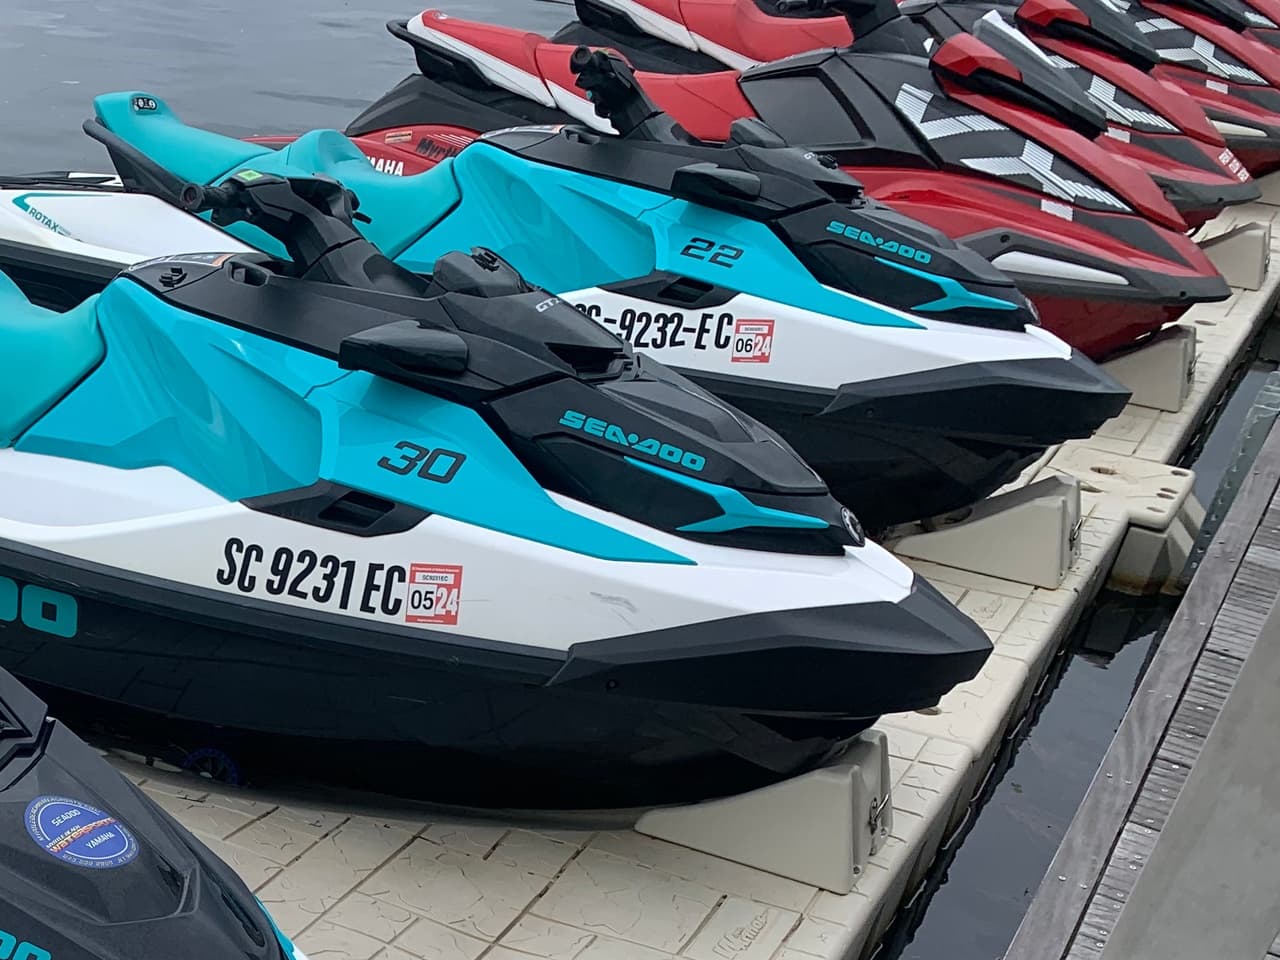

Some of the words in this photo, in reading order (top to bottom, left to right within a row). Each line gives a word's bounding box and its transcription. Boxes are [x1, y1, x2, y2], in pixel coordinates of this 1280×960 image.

[29, 207, 59, 233] ROTAX
[680, 237, 745, 268] 22
[735, 338, 753, 353] 06
[754, 336, 772, 357] 24
[376, 440, 467, 484] 30
[216, 537, 263, 594] SC
[265, 547, 356, 610] 9231
[359, 562, 407, 617] EC
[410, 589, 434, 610] 05
[435, 587, 459, 616] 24
[86, 831, 116, 849] YAMAHA
